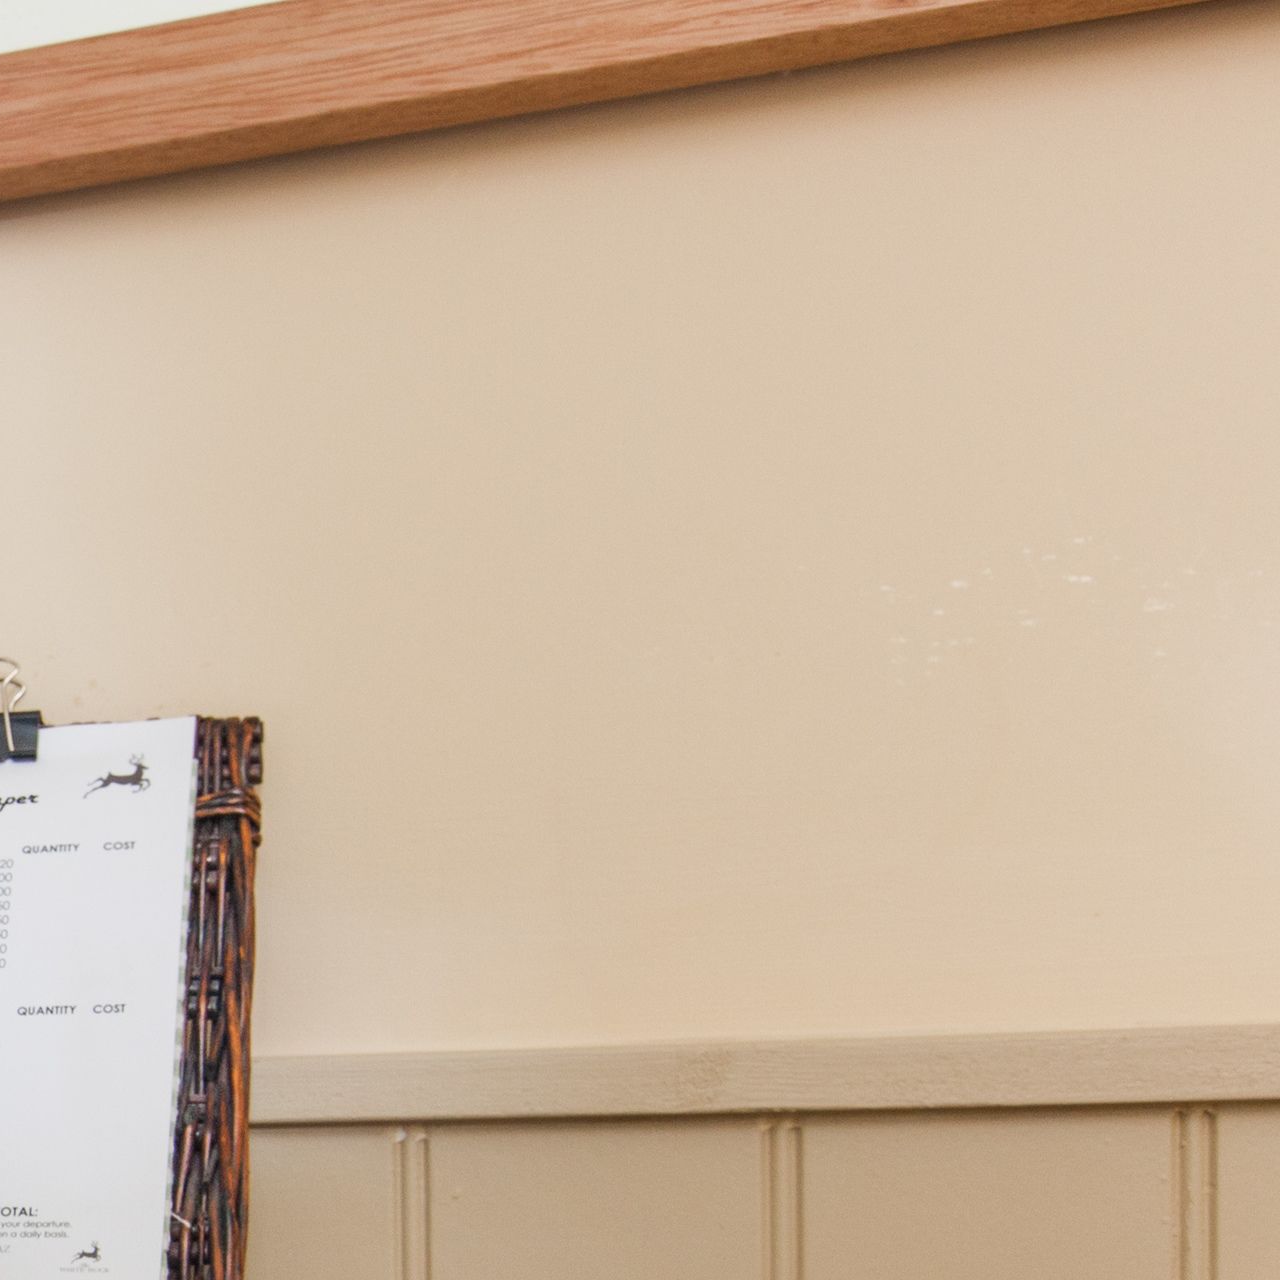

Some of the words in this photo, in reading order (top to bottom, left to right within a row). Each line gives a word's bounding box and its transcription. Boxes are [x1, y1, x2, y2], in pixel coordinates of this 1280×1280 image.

[22, 843, 81, 854] QUANTITY
[103, 841, 137, 851] COST
[16, 1005, 77, 1016] QUANTITY
[93, 1004, 126, 1014] COST
[0, 1221, 21, 1230] your
